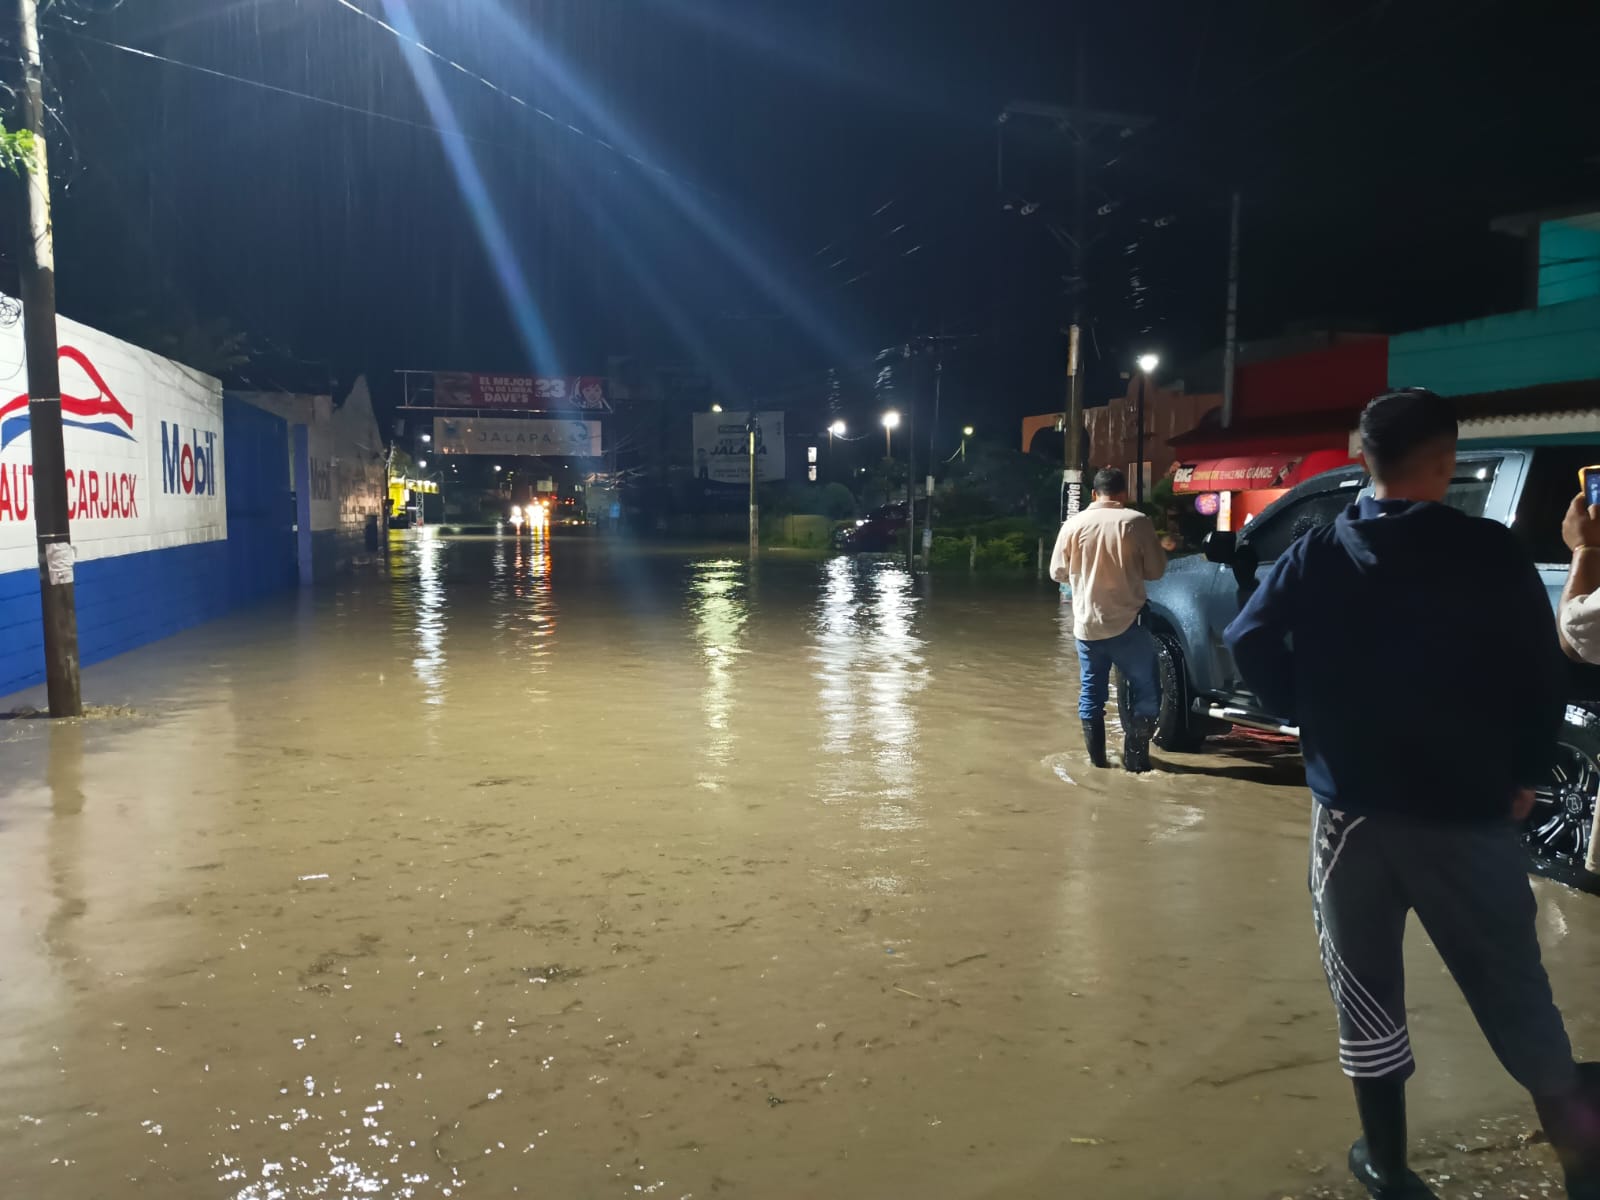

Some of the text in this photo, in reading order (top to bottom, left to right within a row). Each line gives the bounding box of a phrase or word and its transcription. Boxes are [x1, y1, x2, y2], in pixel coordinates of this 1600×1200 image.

[479, 376, 533, 386] EL MEJOR
[484, 393, 529, 403] DAVE'S
[479, 431, 552, 443] JALAPA
[710, 445, 768, 456] JALAA
[161, 420, 215, 496] Mobil
[1174, 468, 1193, 482] BIG
[65, 469, 139, 520] CARJACK
